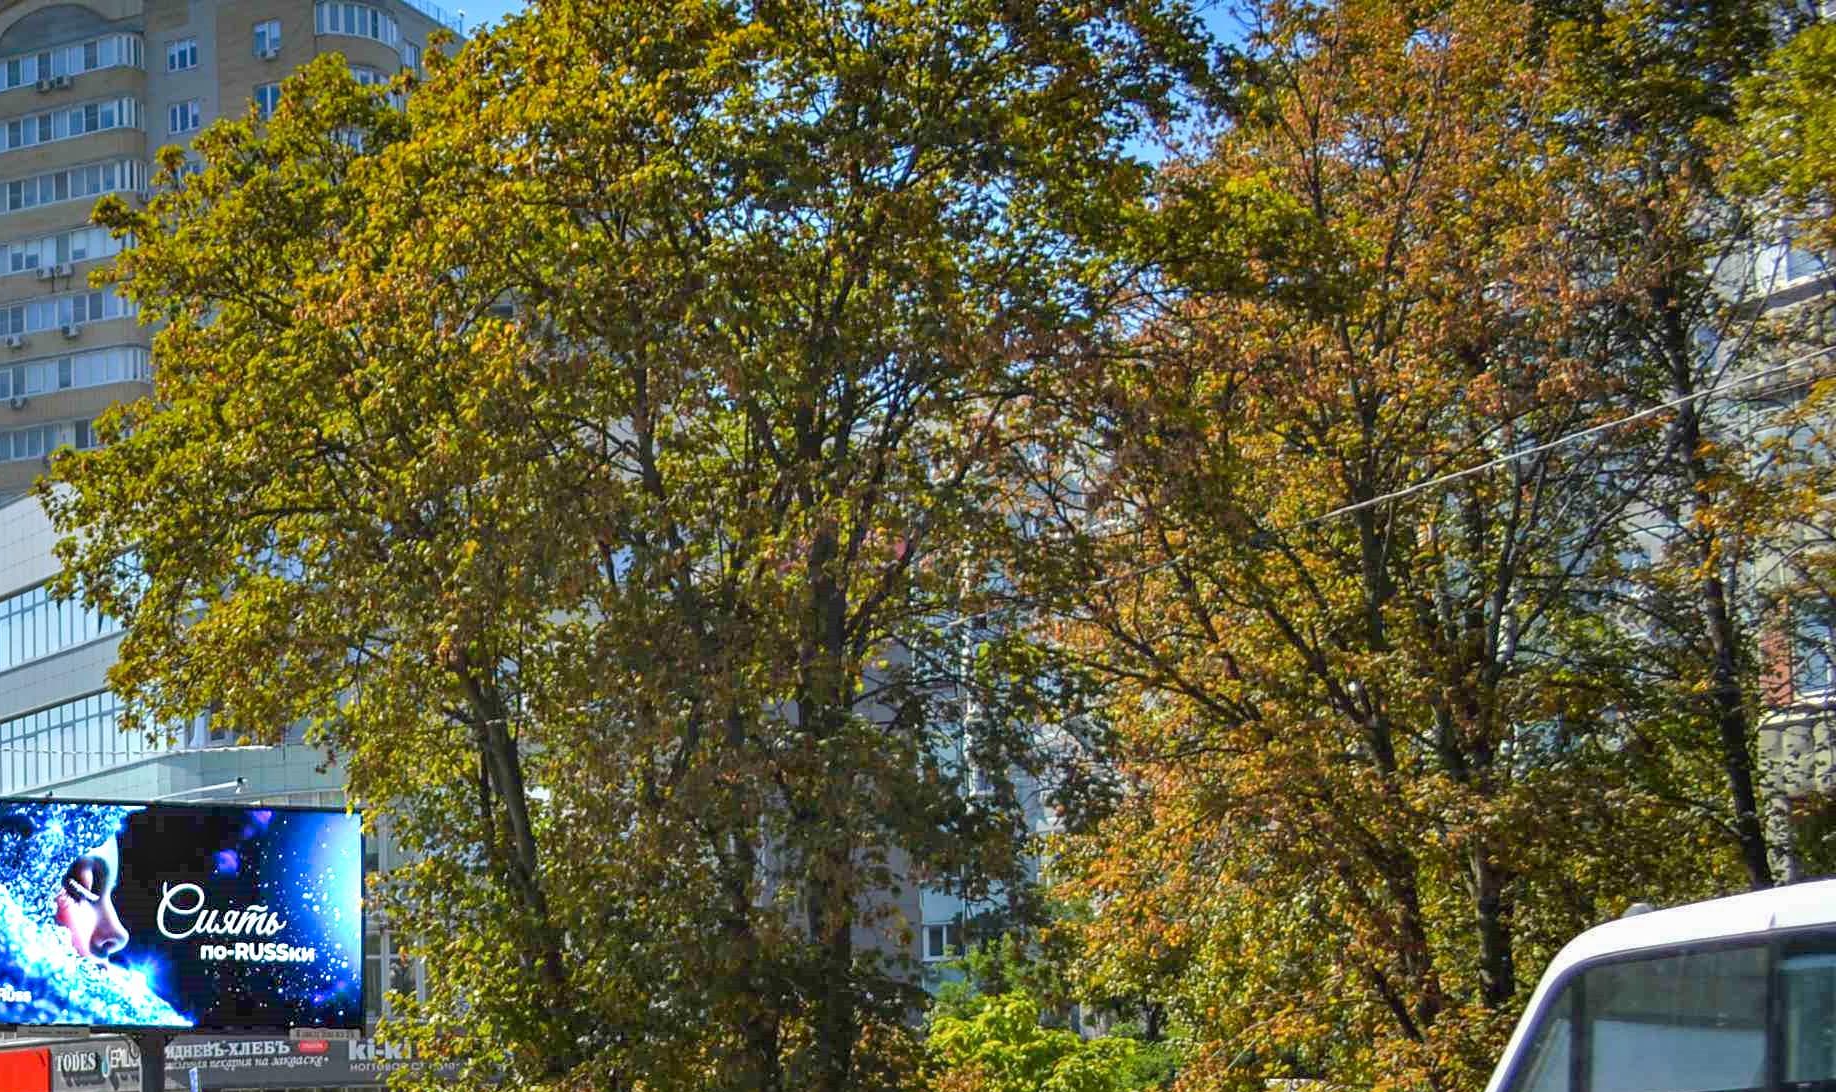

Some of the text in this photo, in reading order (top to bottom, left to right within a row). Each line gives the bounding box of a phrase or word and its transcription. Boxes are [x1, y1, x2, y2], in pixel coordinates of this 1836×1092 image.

[157, 881, 287, 939] Сиять
[200, 942, 315, 962] по-RUSSки
[56, 1052, 97, 1072] TODES
